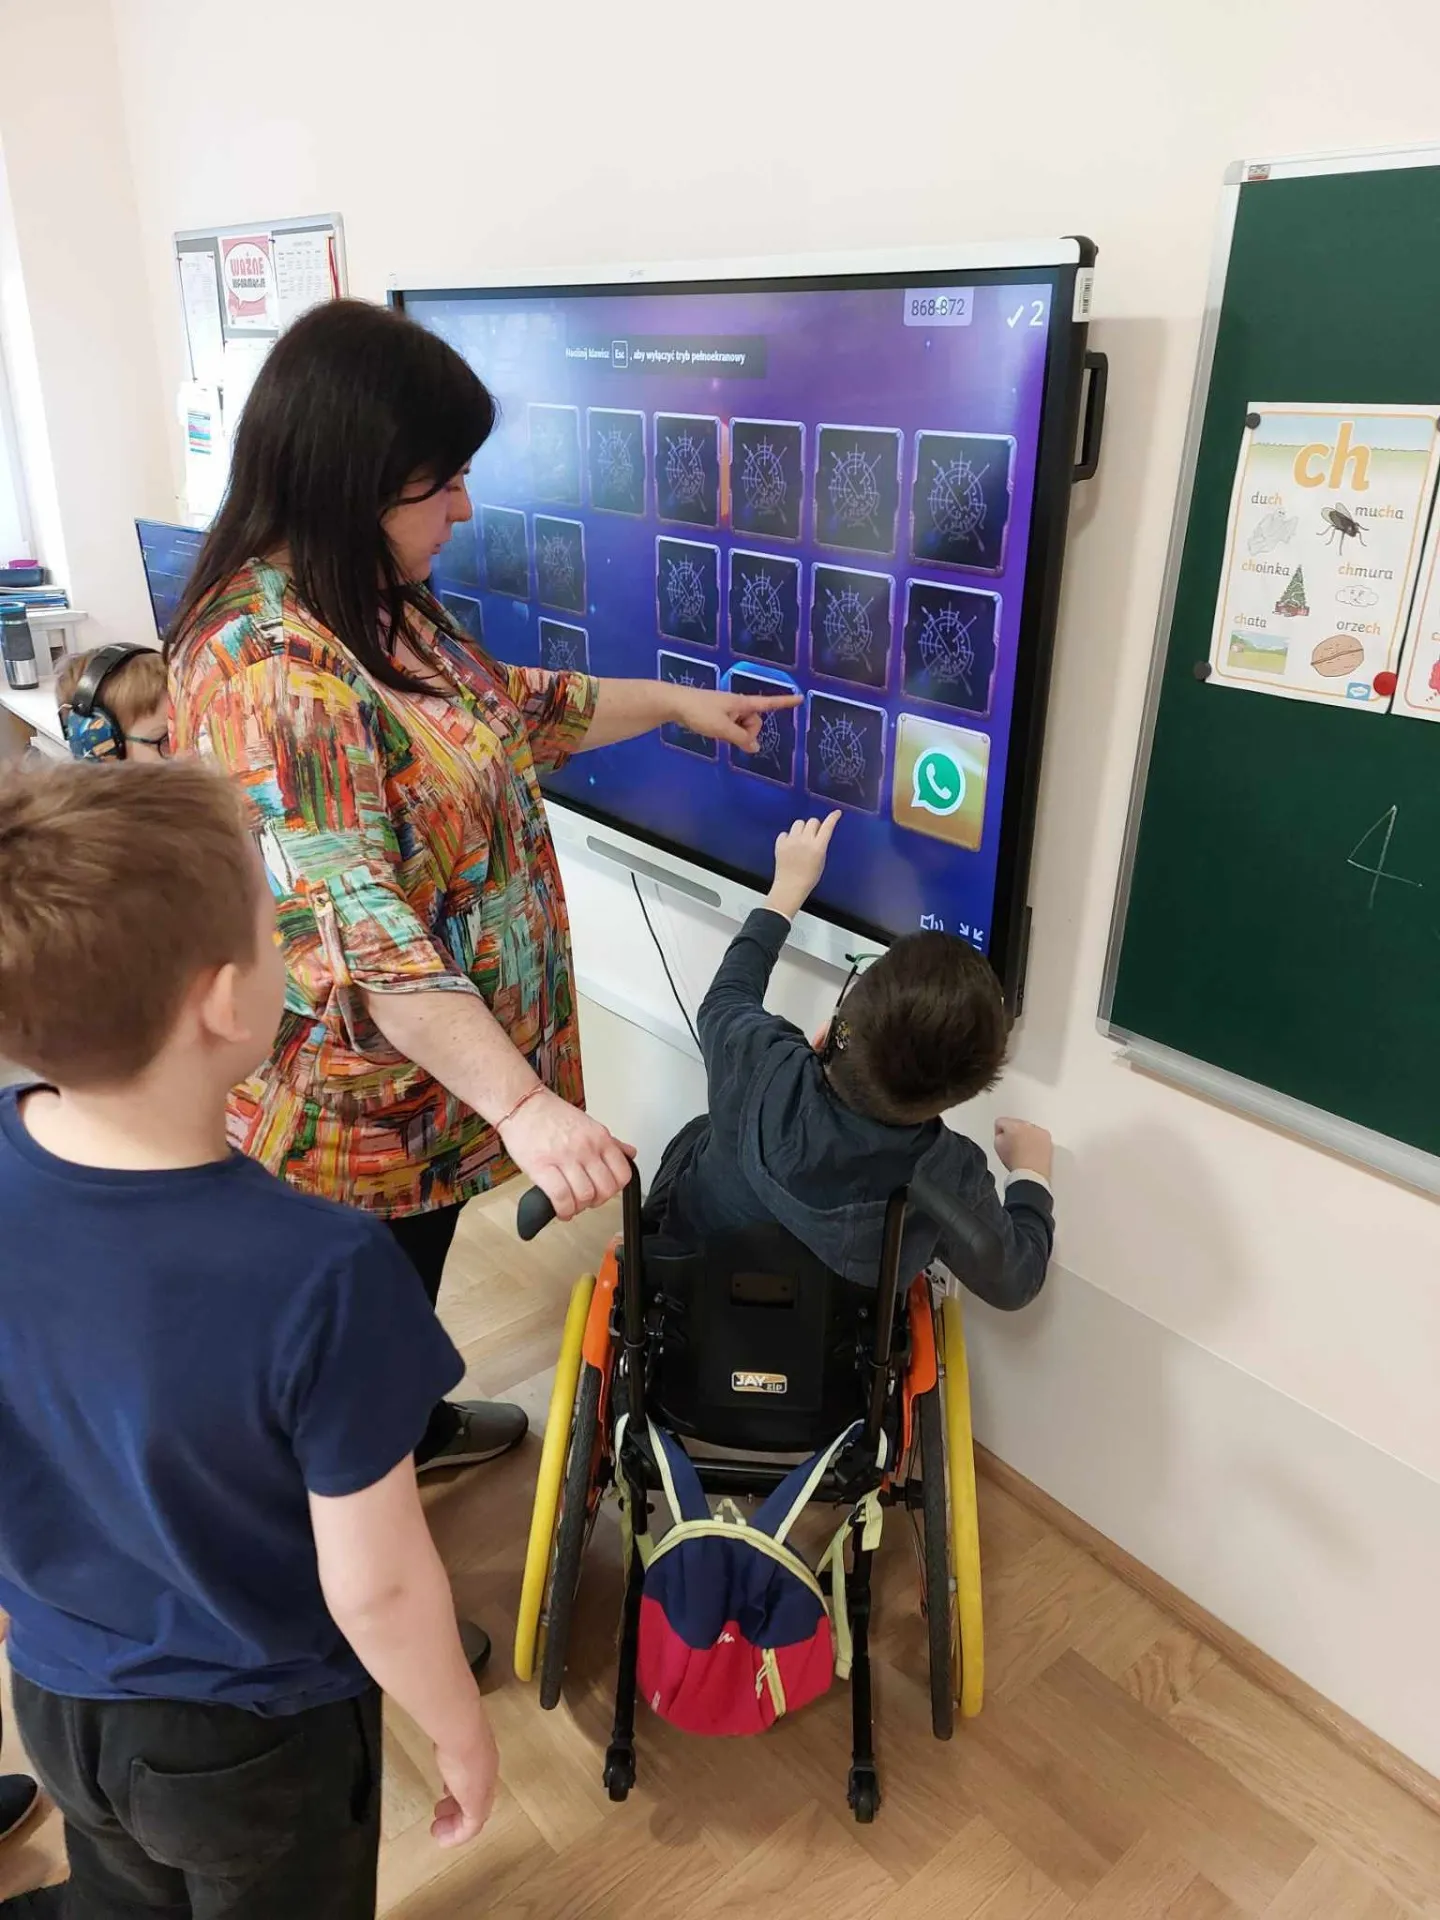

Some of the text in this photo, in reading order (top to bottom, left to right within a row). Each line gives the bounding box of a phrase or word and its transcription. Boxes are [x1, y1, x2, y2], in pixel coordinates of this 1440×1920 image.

[1028, 300, 1044, 326] 2
[614, 349, 625, 359] Esc
[675, 350, 690, 364] tryb
[691, 350, 746, 365] pełnoekranowy
[1293, 420, 1371, 492] ch
[1251, 491, 1283, 505] duch
[1355, 504, 1405, 520] mucha
[1241, 557, 1291, 577] choinka
[1338, 562, 1394, 580] chmura
[1233, 613, 1267, 628] chata
[1336, 620, 1381, 636] orzech
[735, 1374, 766, 1387] JAY
